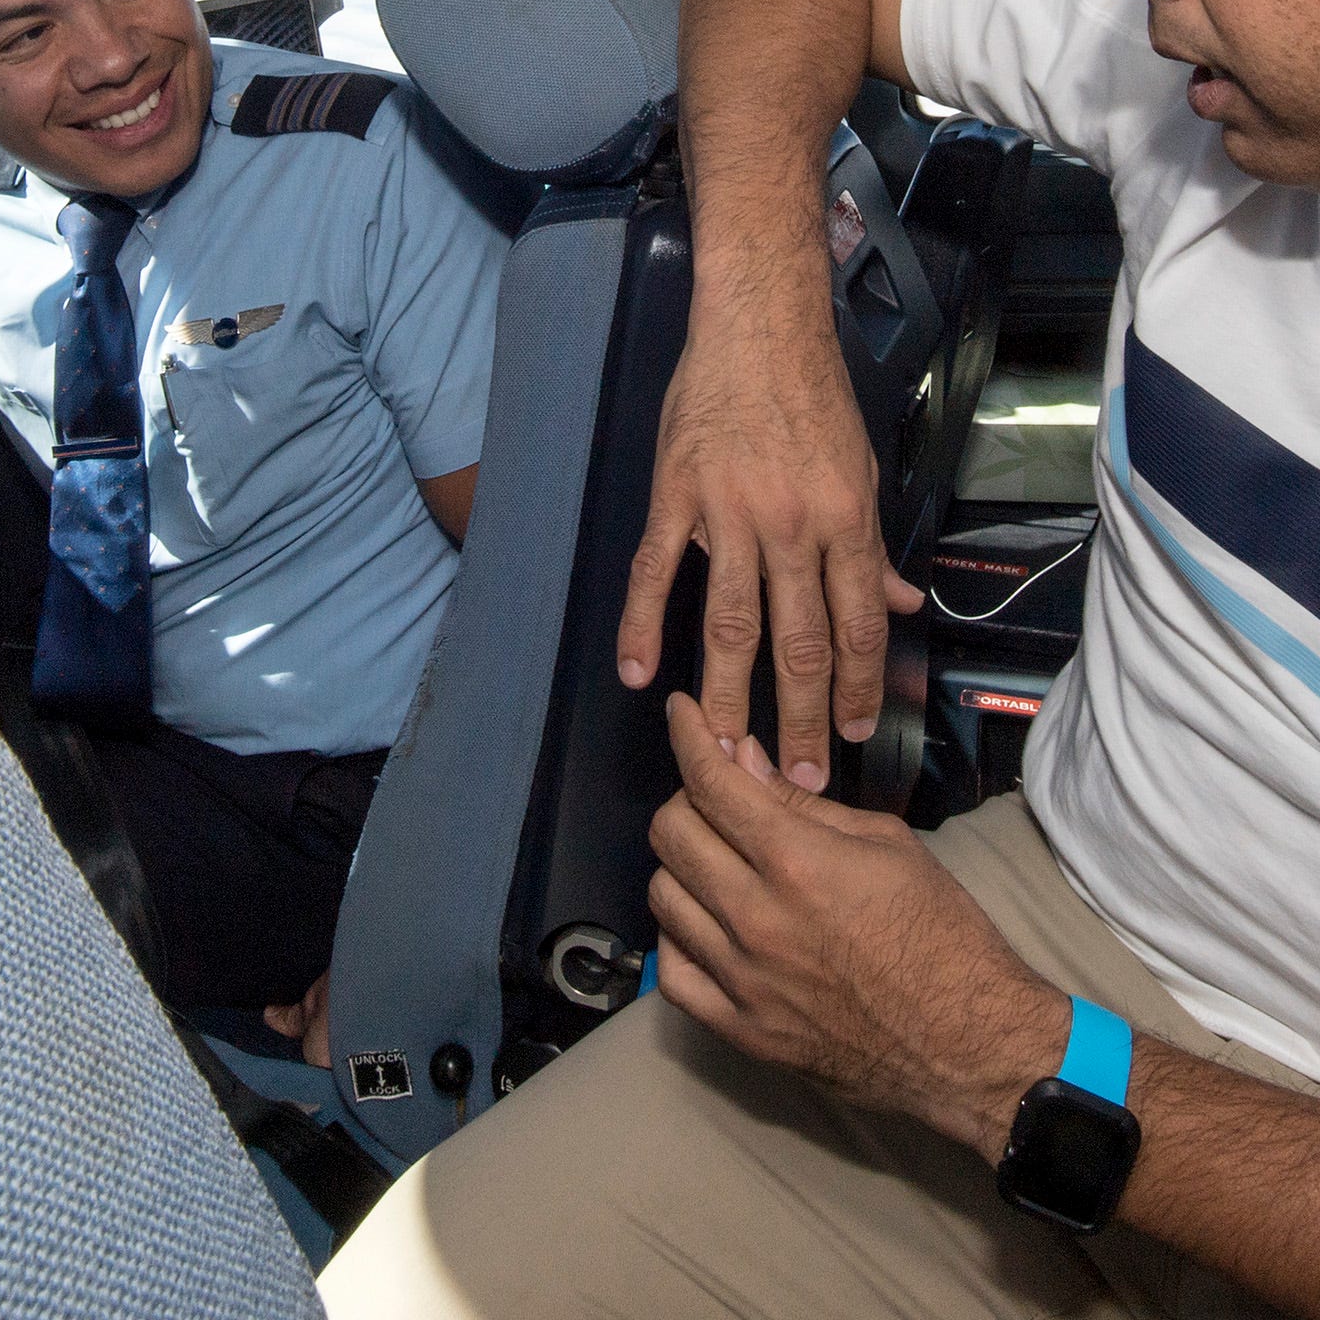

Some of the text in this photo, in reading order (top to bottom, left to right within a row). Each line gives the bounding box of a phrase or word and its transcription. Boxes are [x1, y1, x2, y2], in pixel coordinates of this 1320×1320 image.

[932, 556, 1021, 576] XYGEN MASK
[972, 693, 1042, 712] PORTABL
[354, 1052, 404, 1066] UNLOCK
[368, 1084, 401, 1096] LOCK
